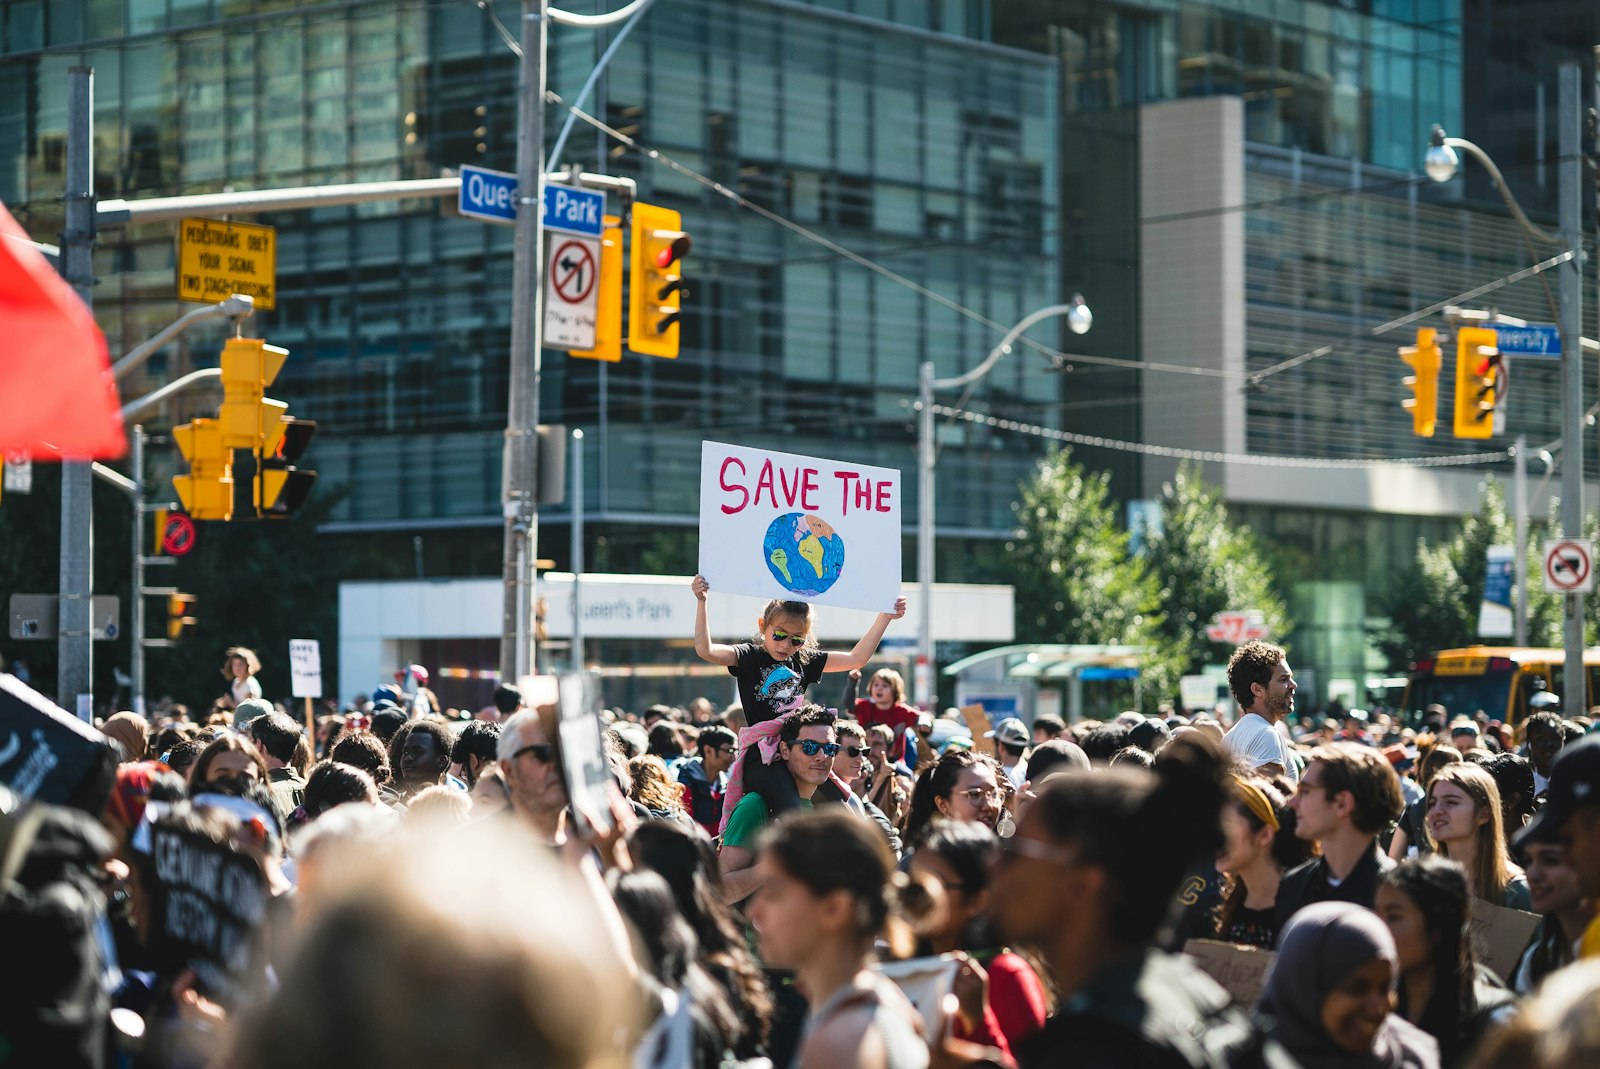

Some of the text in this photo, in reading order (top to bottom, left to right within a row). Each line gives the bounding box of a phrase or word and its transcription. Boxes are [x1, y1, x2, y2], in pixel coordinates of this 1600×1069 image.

[555, 189, 599, 225] Park
[186, 225, 269, 252] PEDESTRIANS OBEY
[199, 252, 256, 276] YOUR SIGNAL
[183, 273, 201, 292] TWO
[719, 456, 893, 516] SAVE THE
[637, 597, 672, 619] Park
[1178, 876, 1207, 905] C
